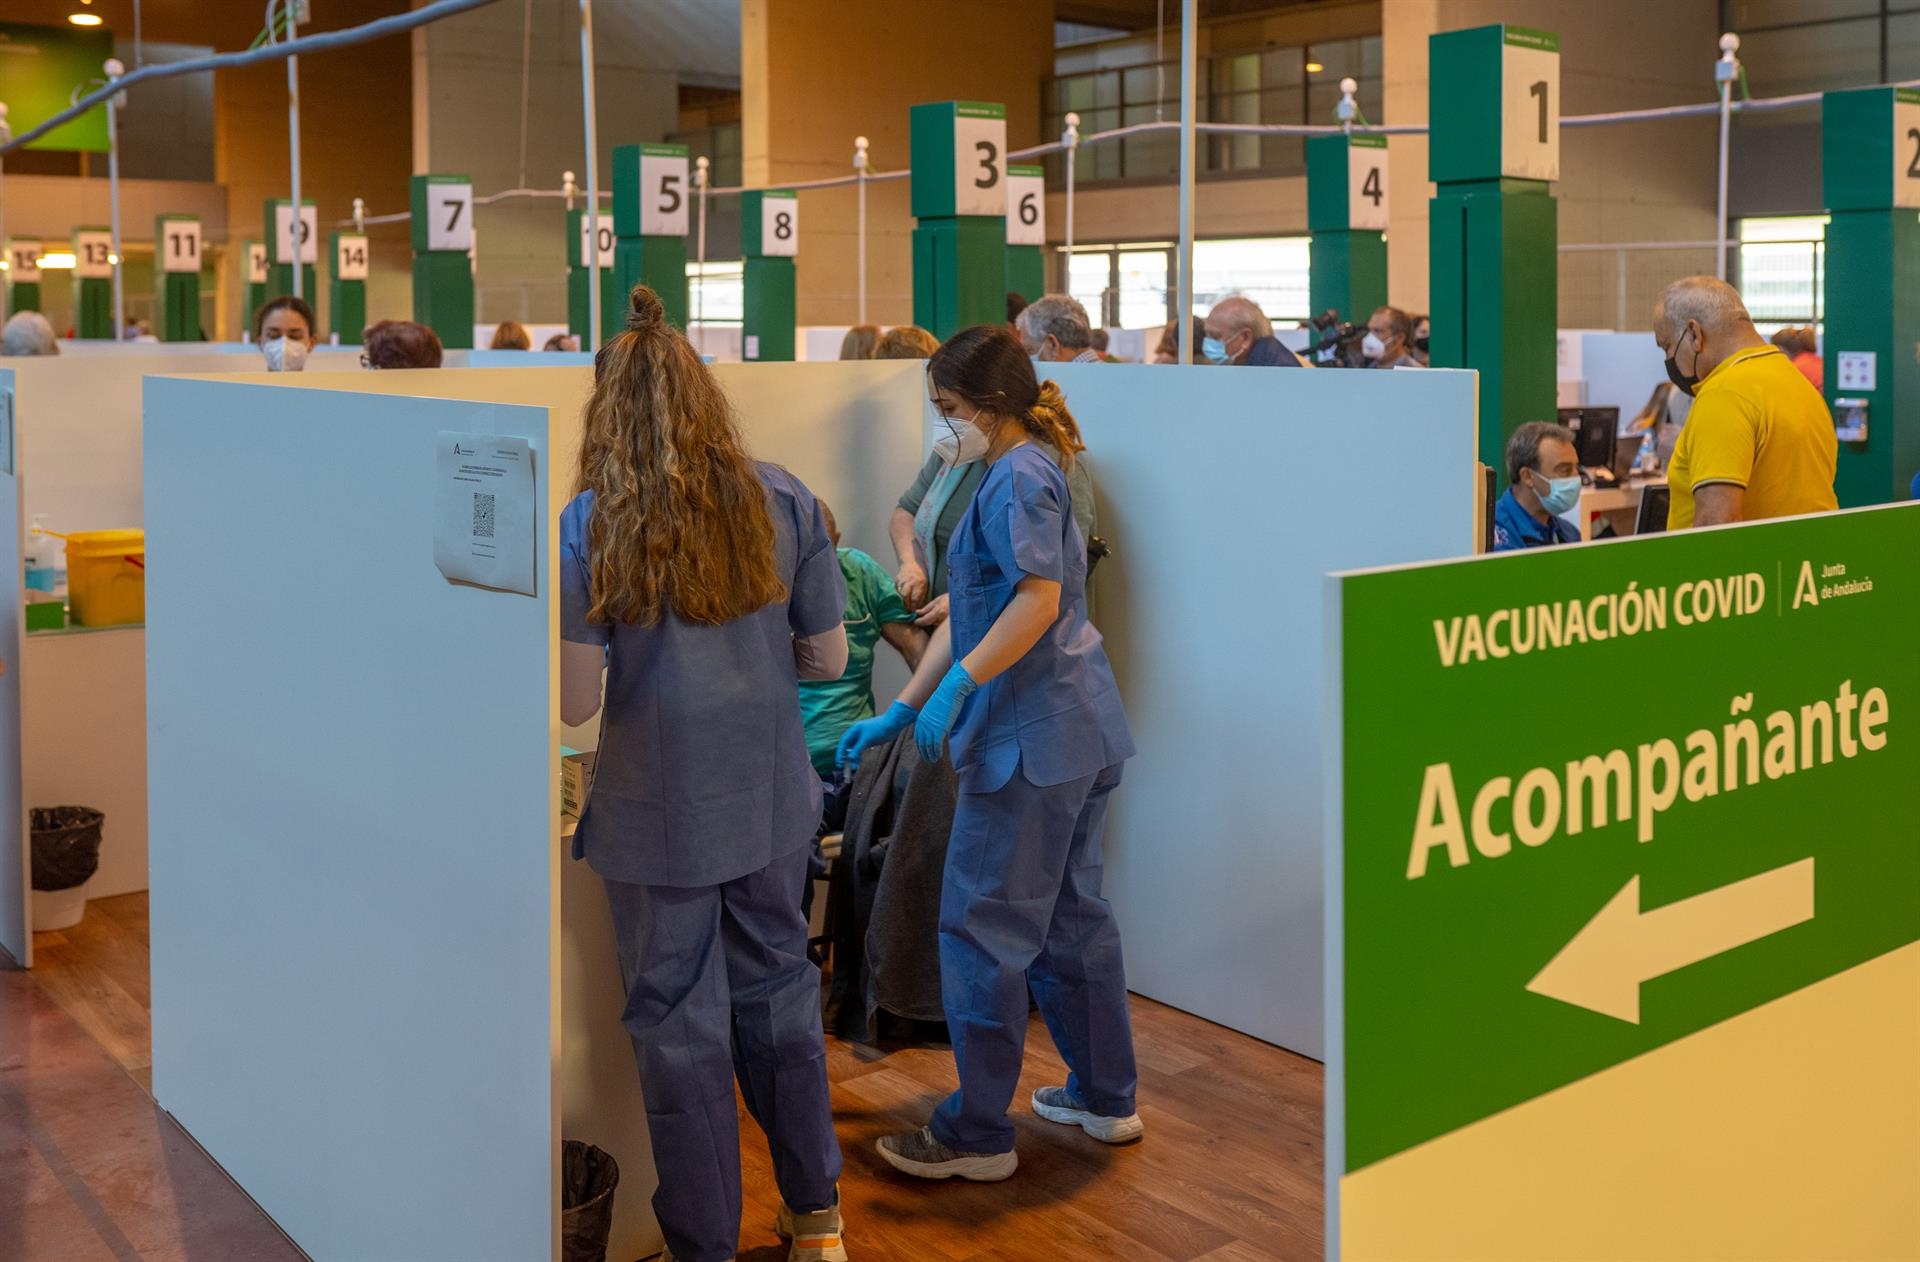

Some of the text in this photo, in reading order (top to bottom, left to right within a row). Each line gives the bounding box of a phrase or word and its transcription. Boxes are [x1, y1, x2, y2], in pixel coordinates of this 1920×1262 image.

[1530, 80, 1549, 144] 1
[974, 140, 999, 189] 3
[658, 176, 682, 214] 5
[1361, 166, 1383, 207] 4
[443, 200, 465, 232] 7
[1019, 193, 1038, 225] 6
[290, 220, 310, 246] 9
[585, 228, 612, 252] 0
[775, 212, 792, 240] 8
[85, 242, 109, 265] 13
[170, 233, 196, 258] 11
[342, 248, 365, 267] 14
[14, 250, 36, 271] 15
[1821, 563, 1846, 578] Junta
[1821, 576, 1873, 599] de Andalucía
[1432, 572, 1766, 668] VACUNACIÓN COVID
[1406, 679, 1890, 880] Acompañante
